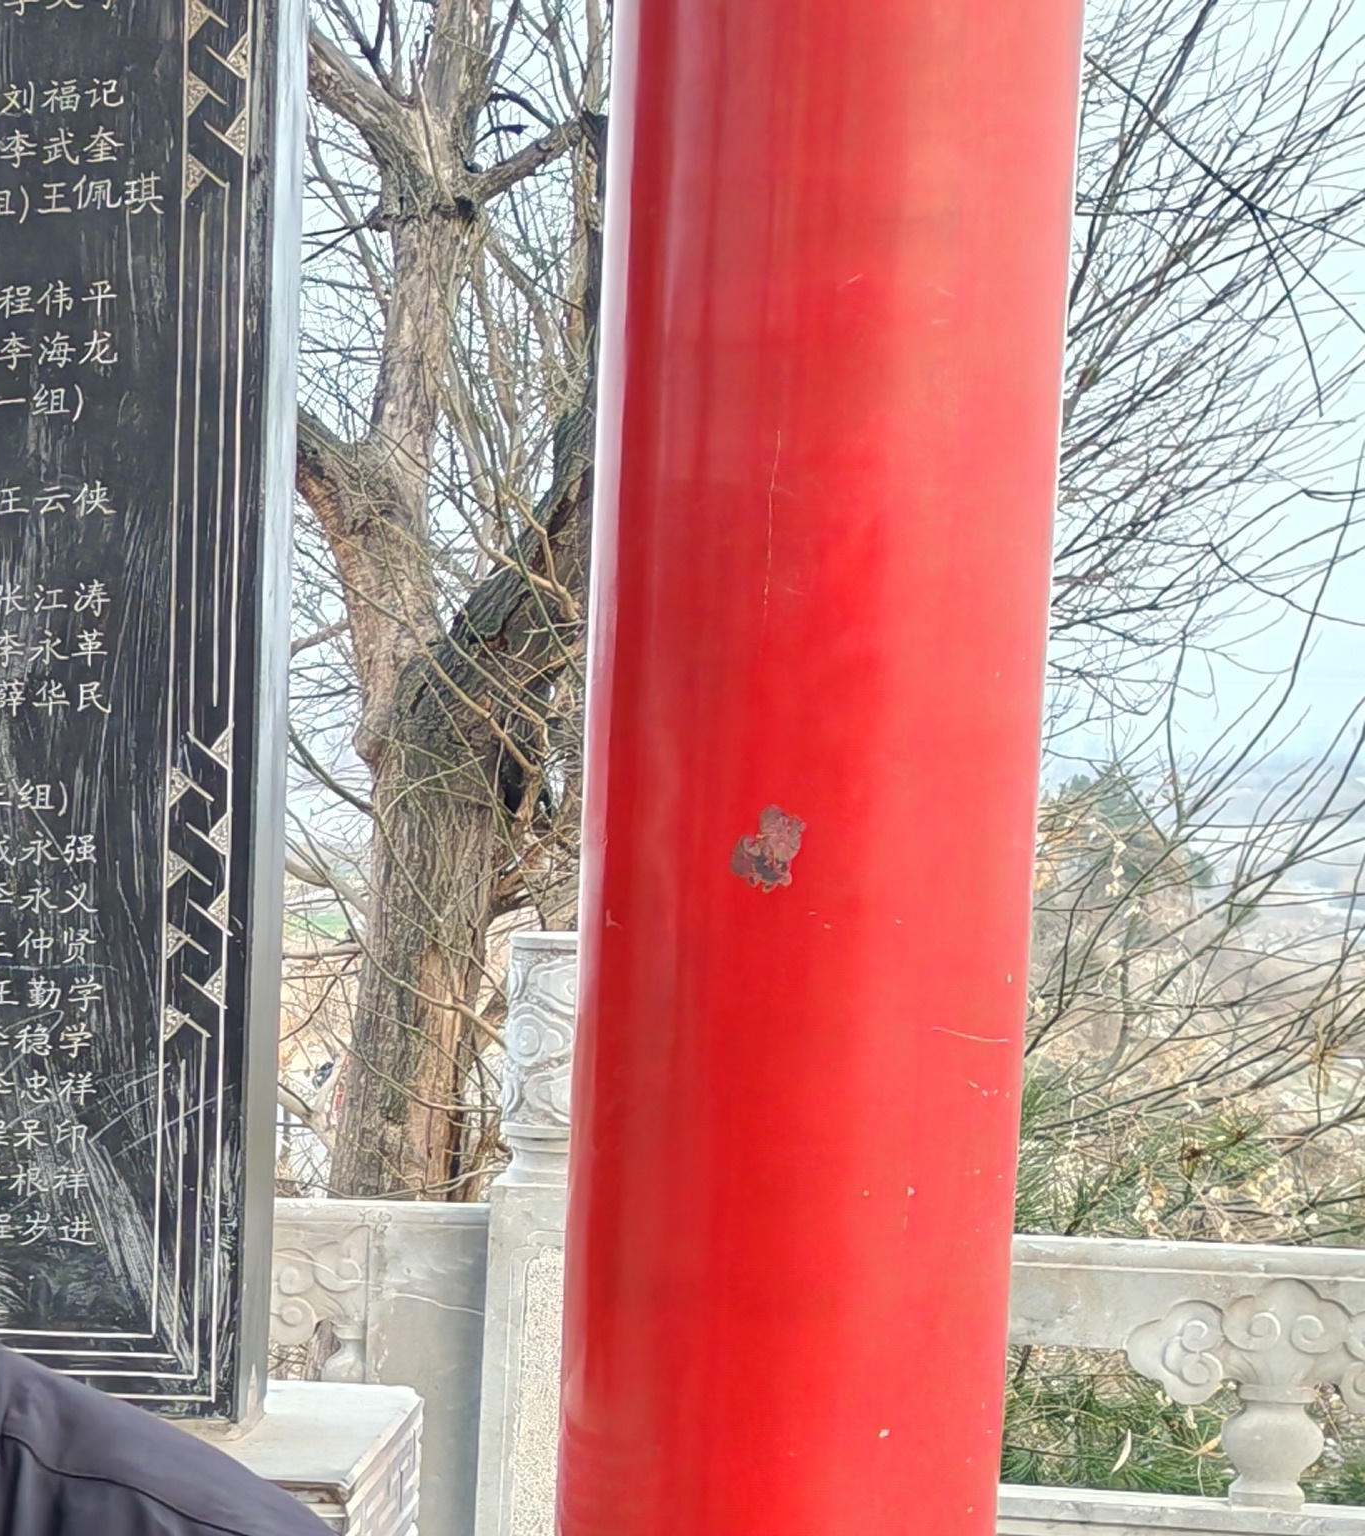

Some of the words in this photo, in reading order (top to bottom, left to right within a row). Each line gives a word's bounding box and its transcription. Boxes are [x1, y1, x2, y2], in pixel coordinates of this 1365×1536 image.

[1, 78, 125, 116] 刘福记
[0, 125, 125, 169] 李武奎
